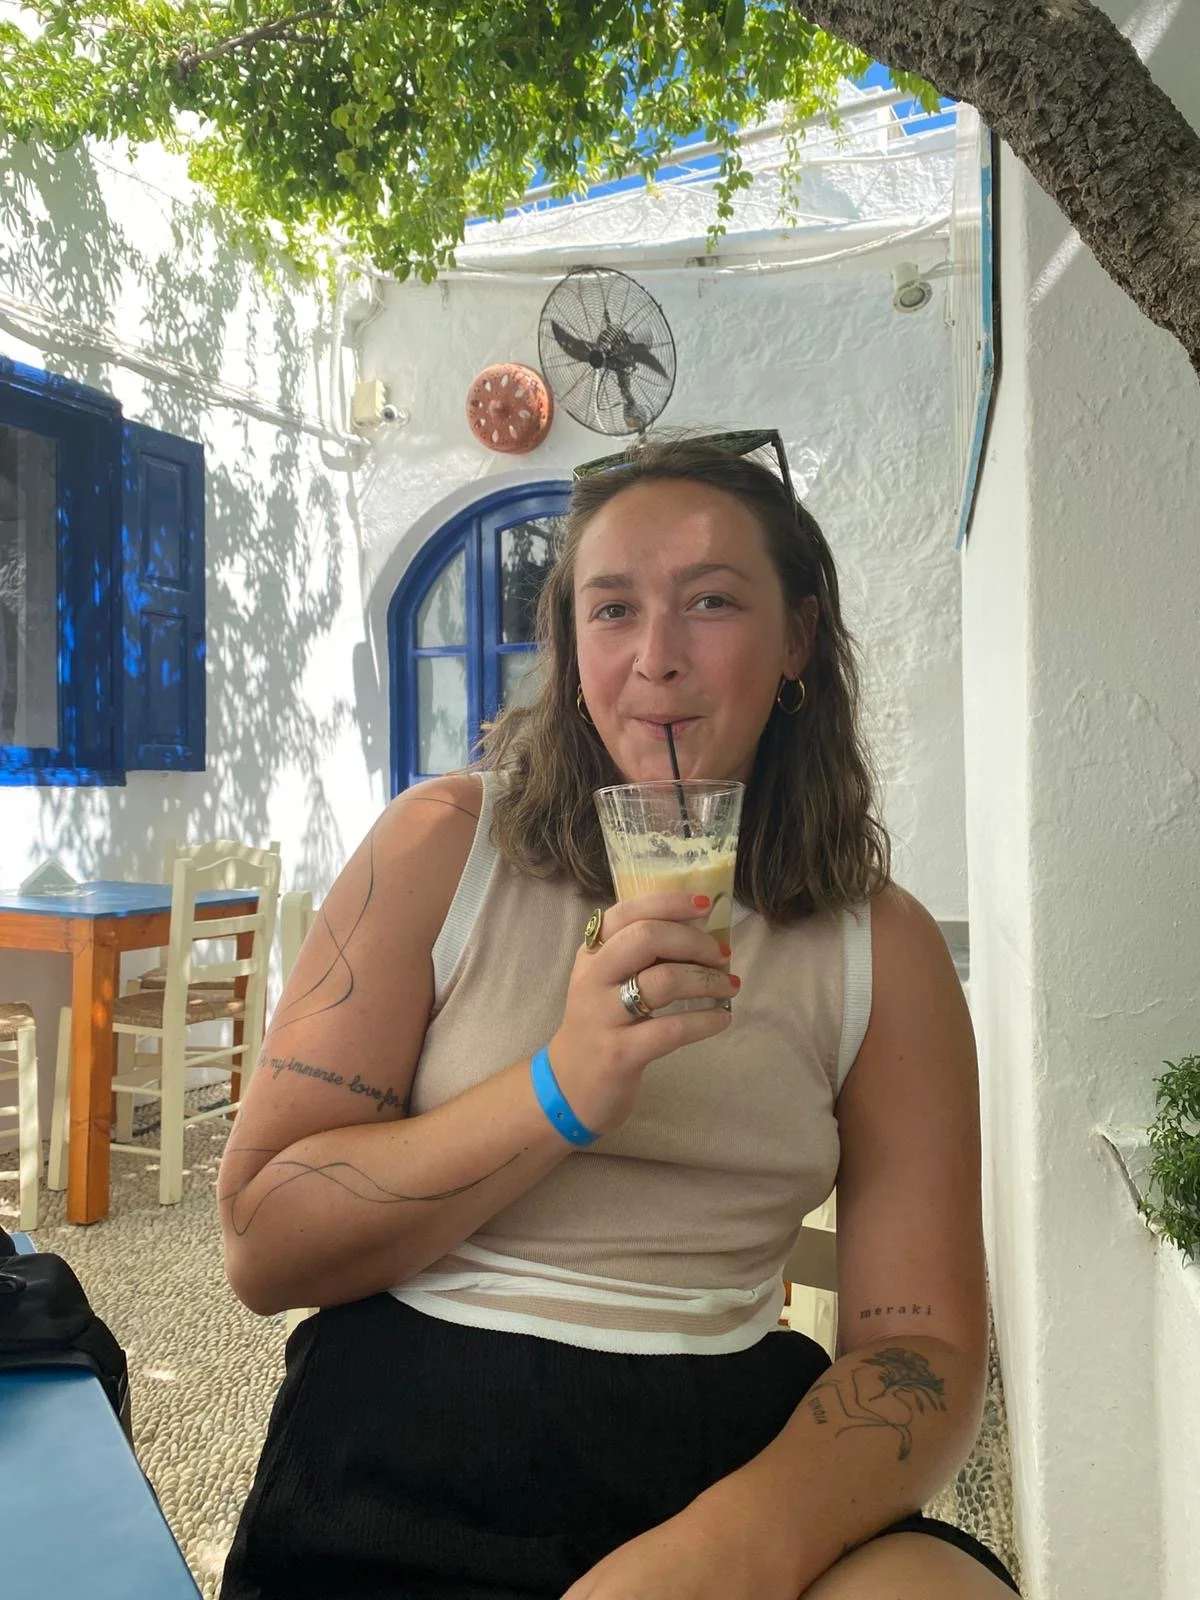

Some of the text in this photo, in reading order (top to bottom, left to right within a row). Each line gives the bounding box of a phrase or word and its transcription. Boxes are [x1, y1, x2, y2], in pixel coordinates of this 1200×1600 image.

[271, 1057, 287, 1080] my
[287, 1057, 344, 1086] immense
[348, 1075, 382, 1100] love
[860, 1303, 933, 1320] meraki
